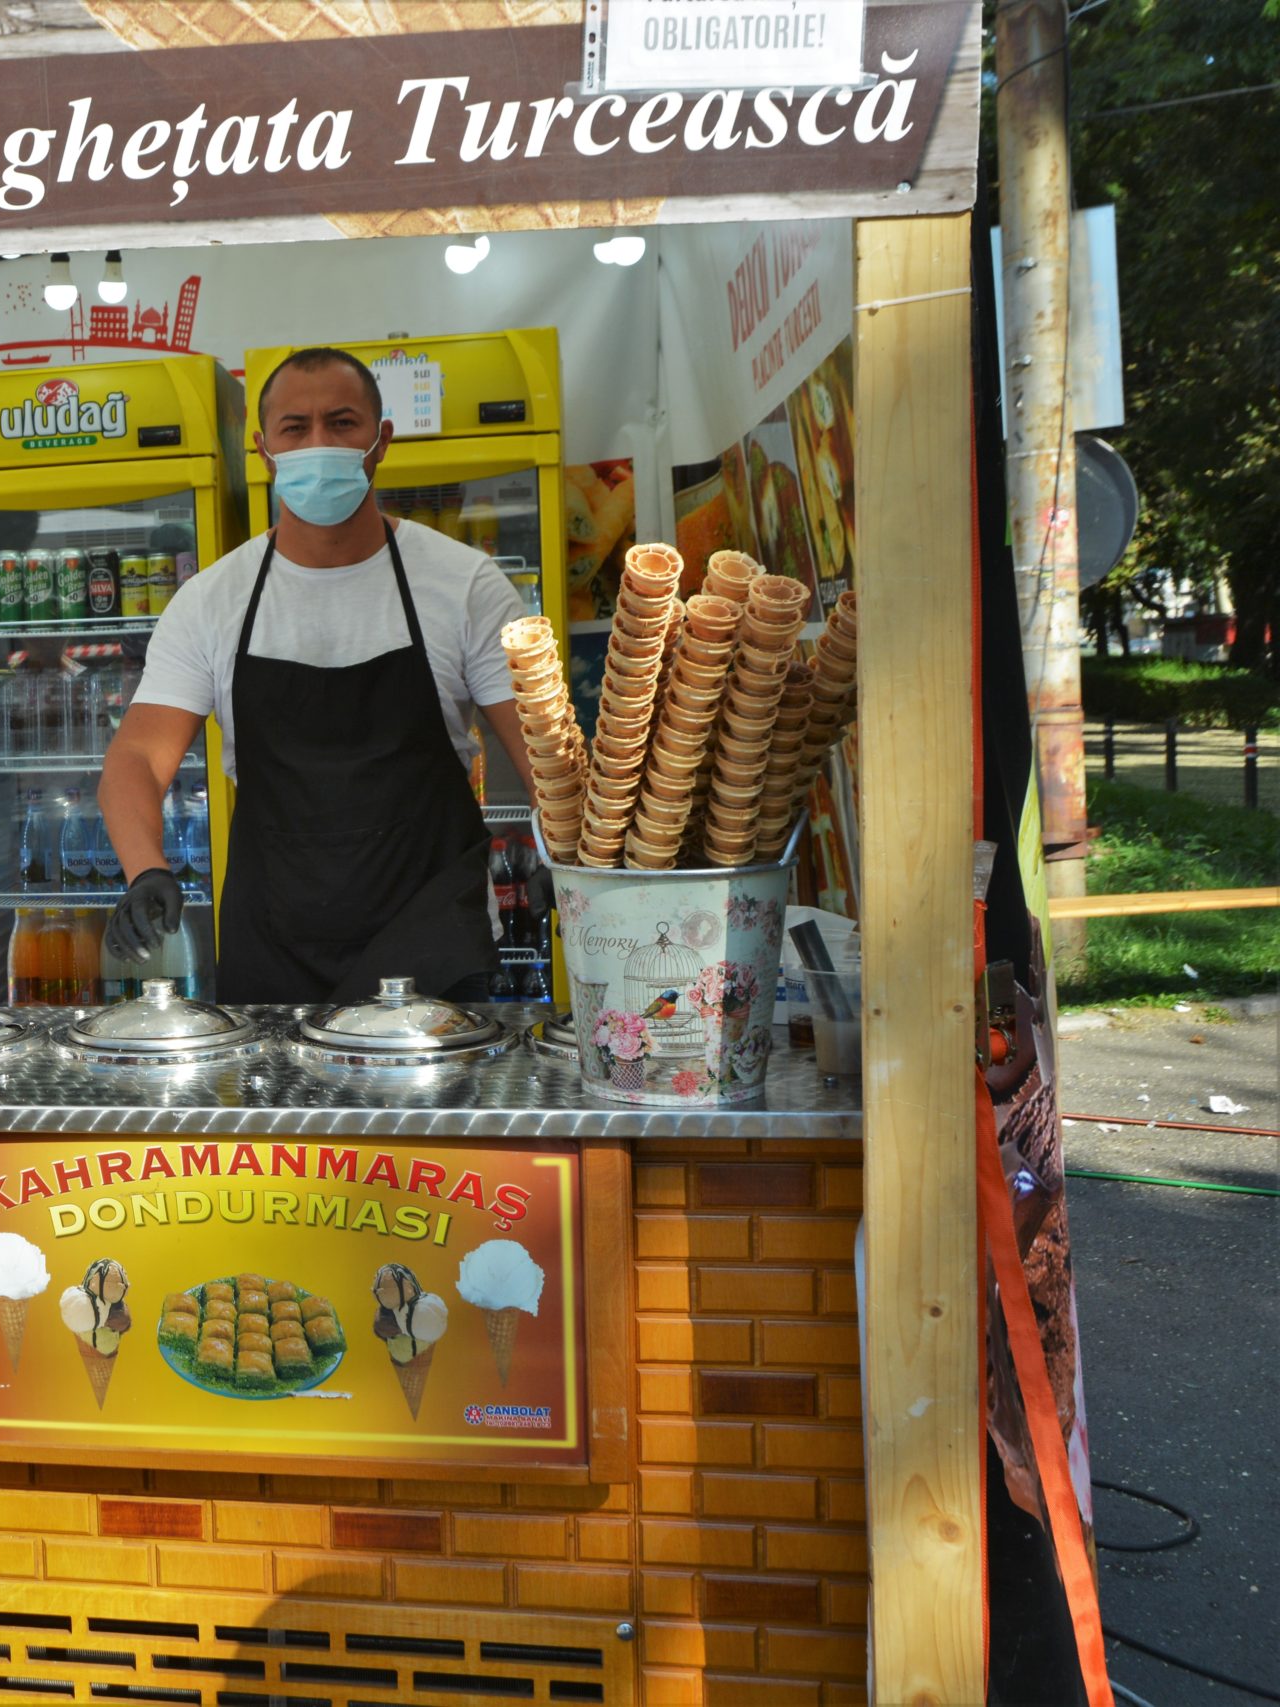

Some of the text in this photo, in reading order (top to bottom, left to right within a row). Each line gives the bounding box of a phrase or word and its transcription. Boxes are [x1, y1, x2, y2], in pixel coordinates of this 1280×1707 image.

[643, 13, 826, 51] OBLIGATORIE!
[394, 48, 918, 165] Turcească
[0, 391, 128, 439] uludağ
[30, 437, 91, 448] BEVERAGE
[90, 584, 112, 593] SILVA
[570, 924, 639, 961] Memory
[49, 1190, 452, 1247] DONDURMASI
[485, 1405, 550, 1416] CANBOLAT
